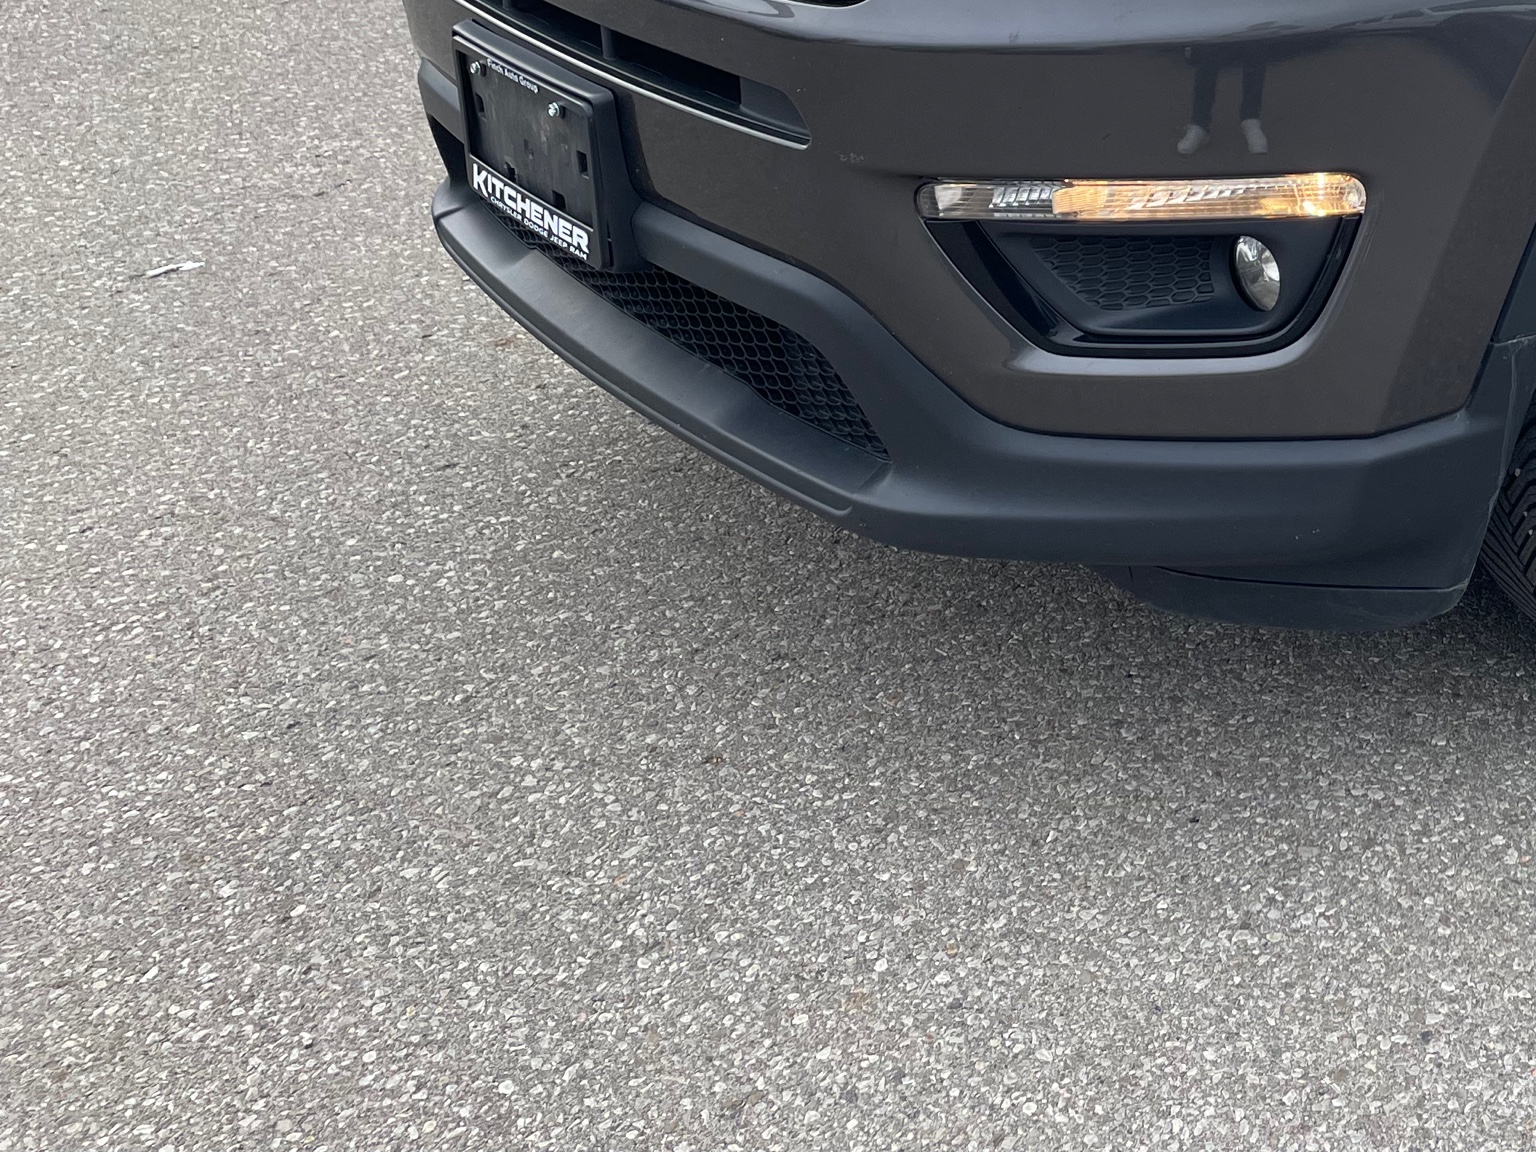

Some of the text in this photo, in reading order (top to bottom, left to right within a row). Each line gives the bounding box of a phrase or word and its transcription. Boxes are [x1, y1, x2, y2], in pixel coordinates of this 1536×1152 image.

[504, 68, 519, 83] Auto
[519, 75, 539, 94] Group
[472, 163, 589, 254] KITCHENER
[488, 196, 588, 261] CHRYSLER DODGE JEEP RAM
